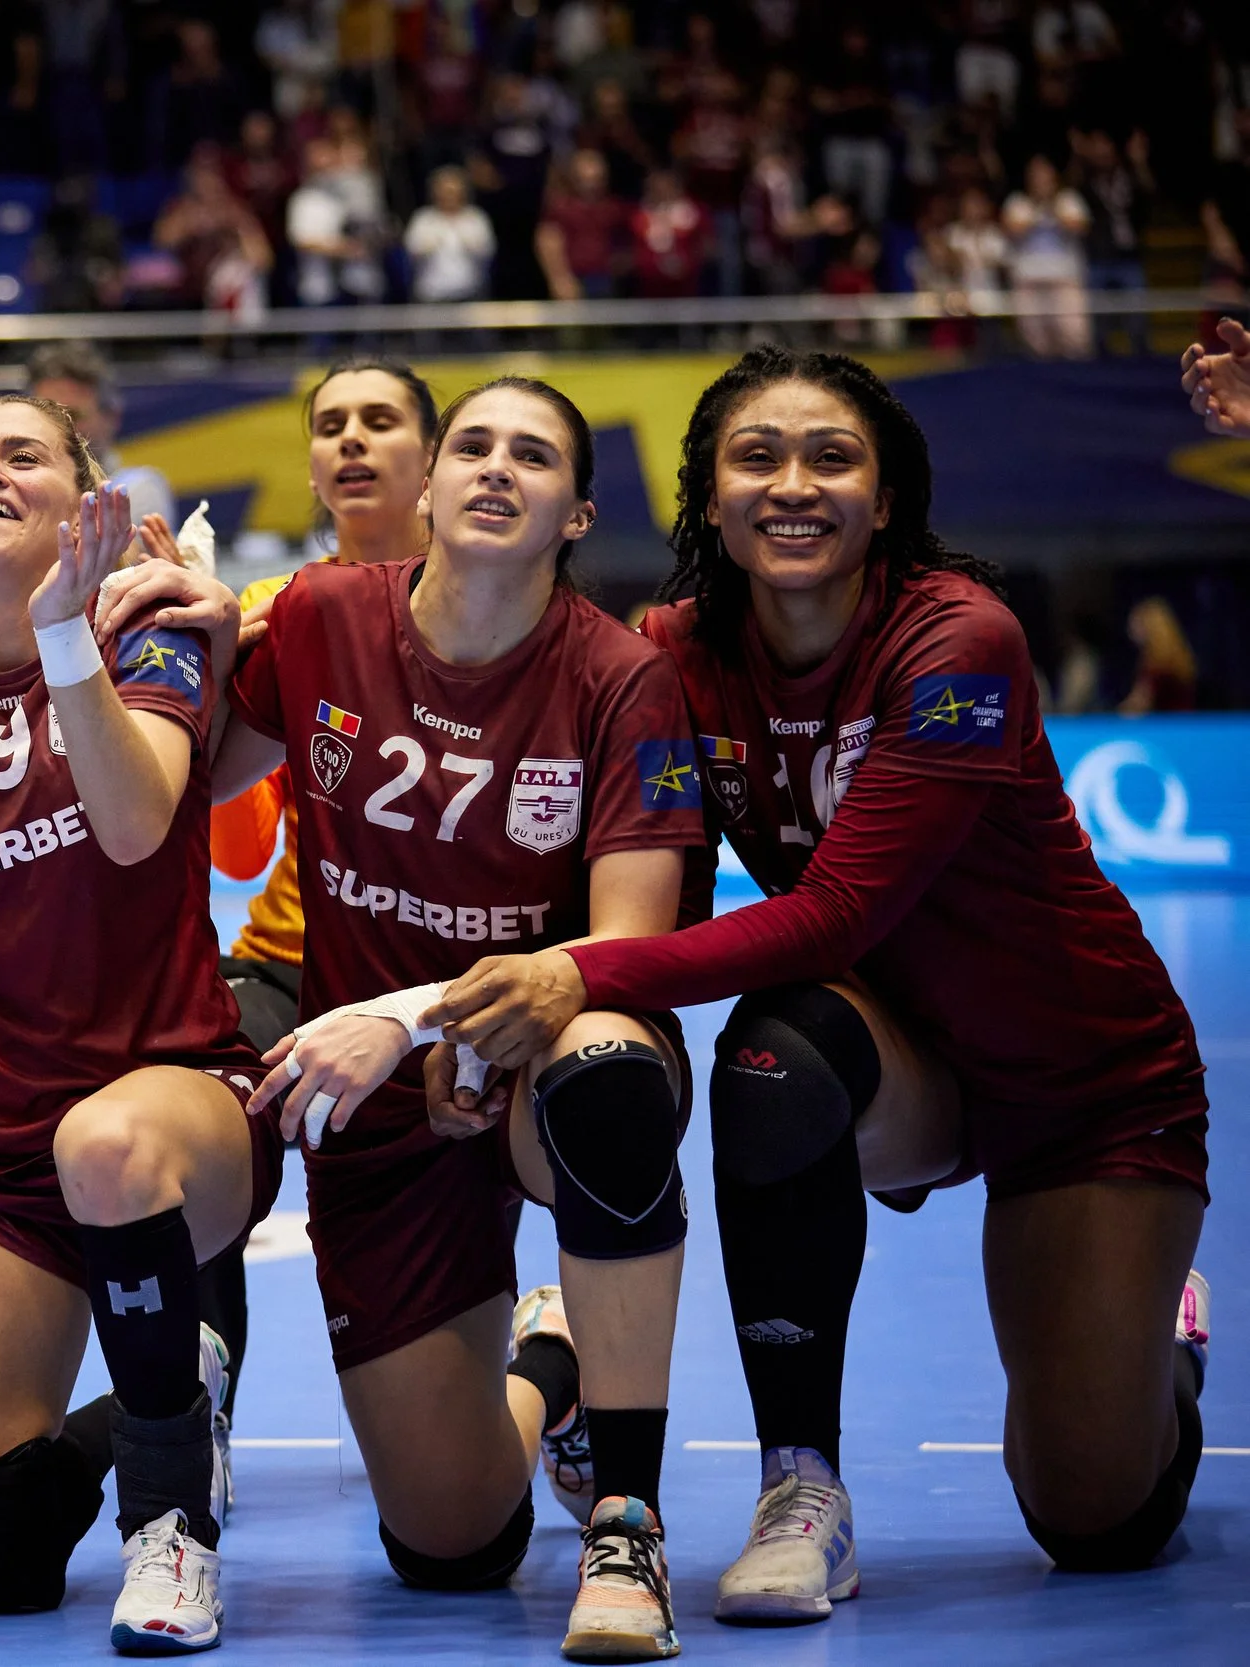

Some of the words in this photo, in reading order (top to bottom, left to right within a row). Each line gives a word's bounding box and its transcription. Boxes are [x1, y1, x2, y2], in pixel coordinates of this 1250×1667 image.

[413, 703, 483, 741] Kempa
[972, 706, 1004, 718] CHAMPIONS
[976, 717, 997, 728] LEAGUE
[323, 748, 339, 768] 100
[364, 735, 494, 842] 27
[320, 859, 551, 942] SUPERBET
